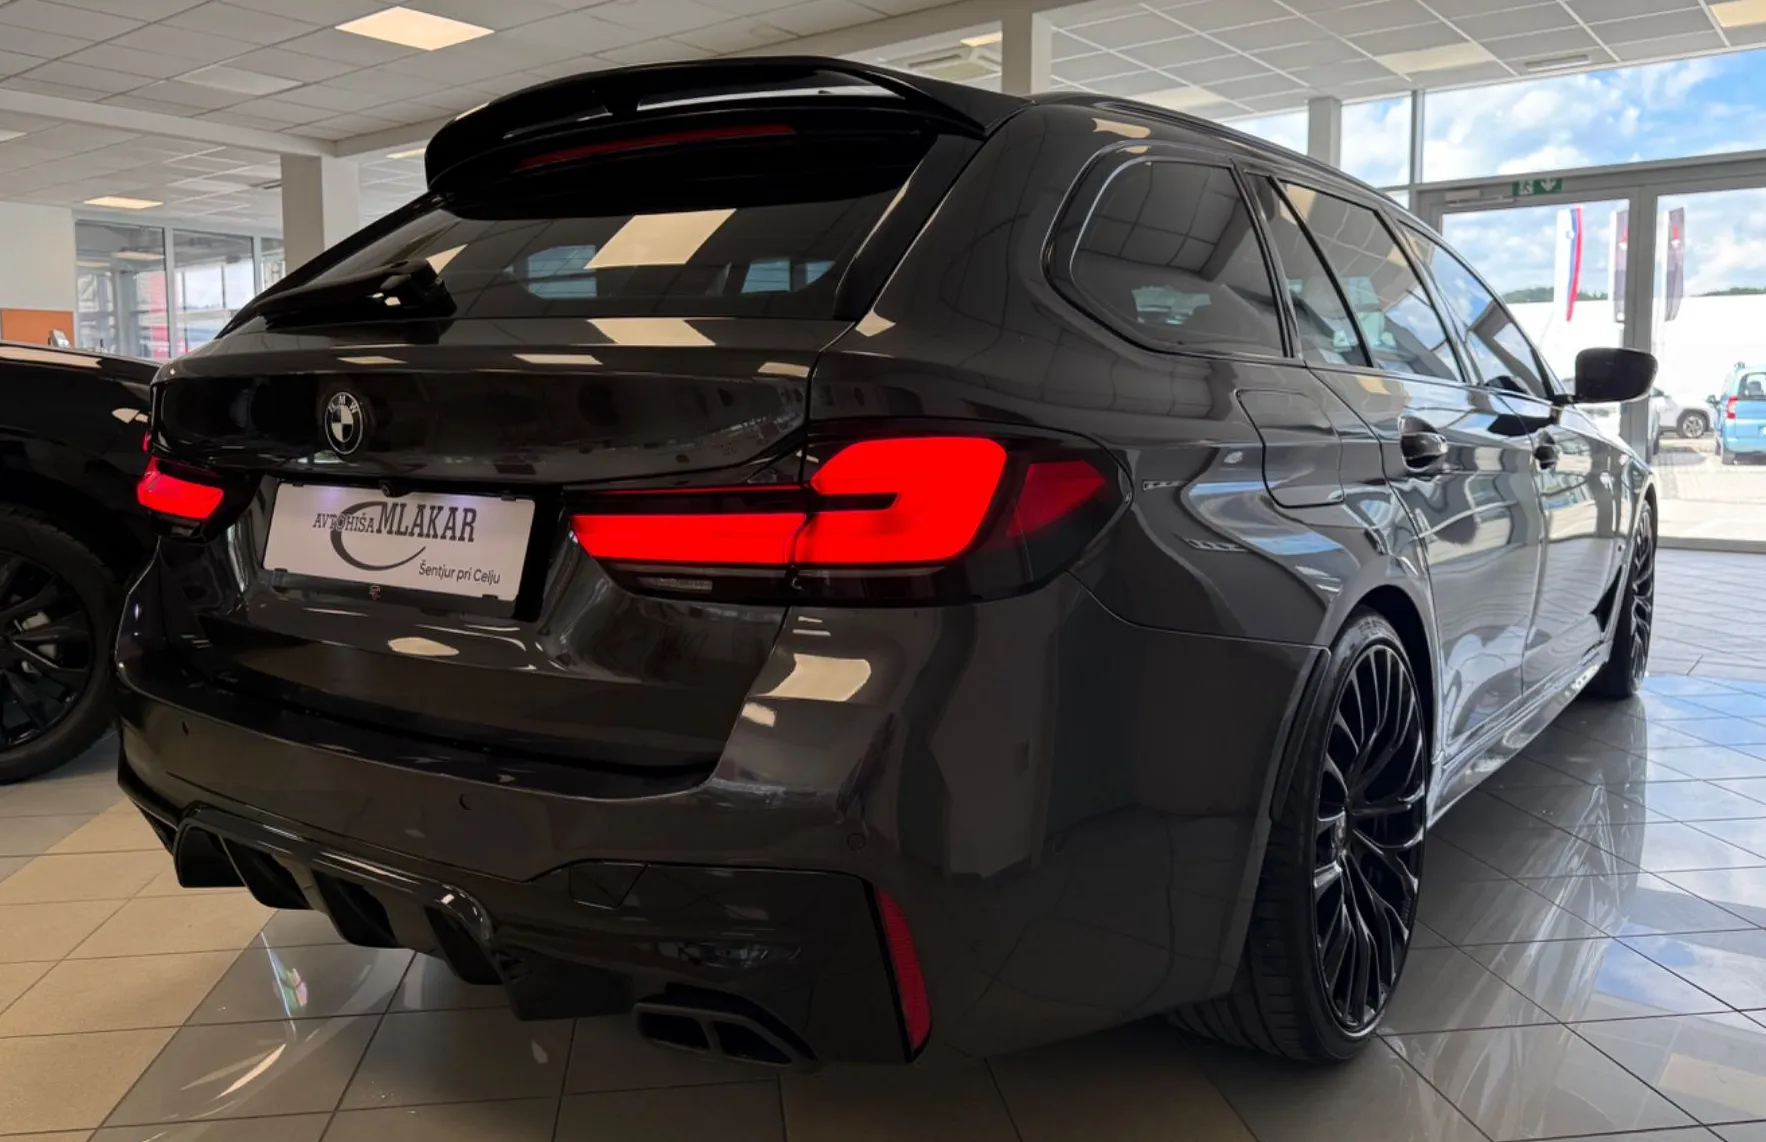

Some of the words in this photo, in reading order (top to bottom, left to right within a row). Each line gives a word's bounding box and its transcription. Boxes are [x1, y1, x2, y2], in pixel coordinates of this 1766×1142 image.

[312, 512, 375, 534] AVTOHIŠA
[375, 501, 477, 543] MLAKAR
[418, 559, 455, 580] Šentjur
[456, 567, 472, 582] pri
[473, 568, 500, 586] Celju
